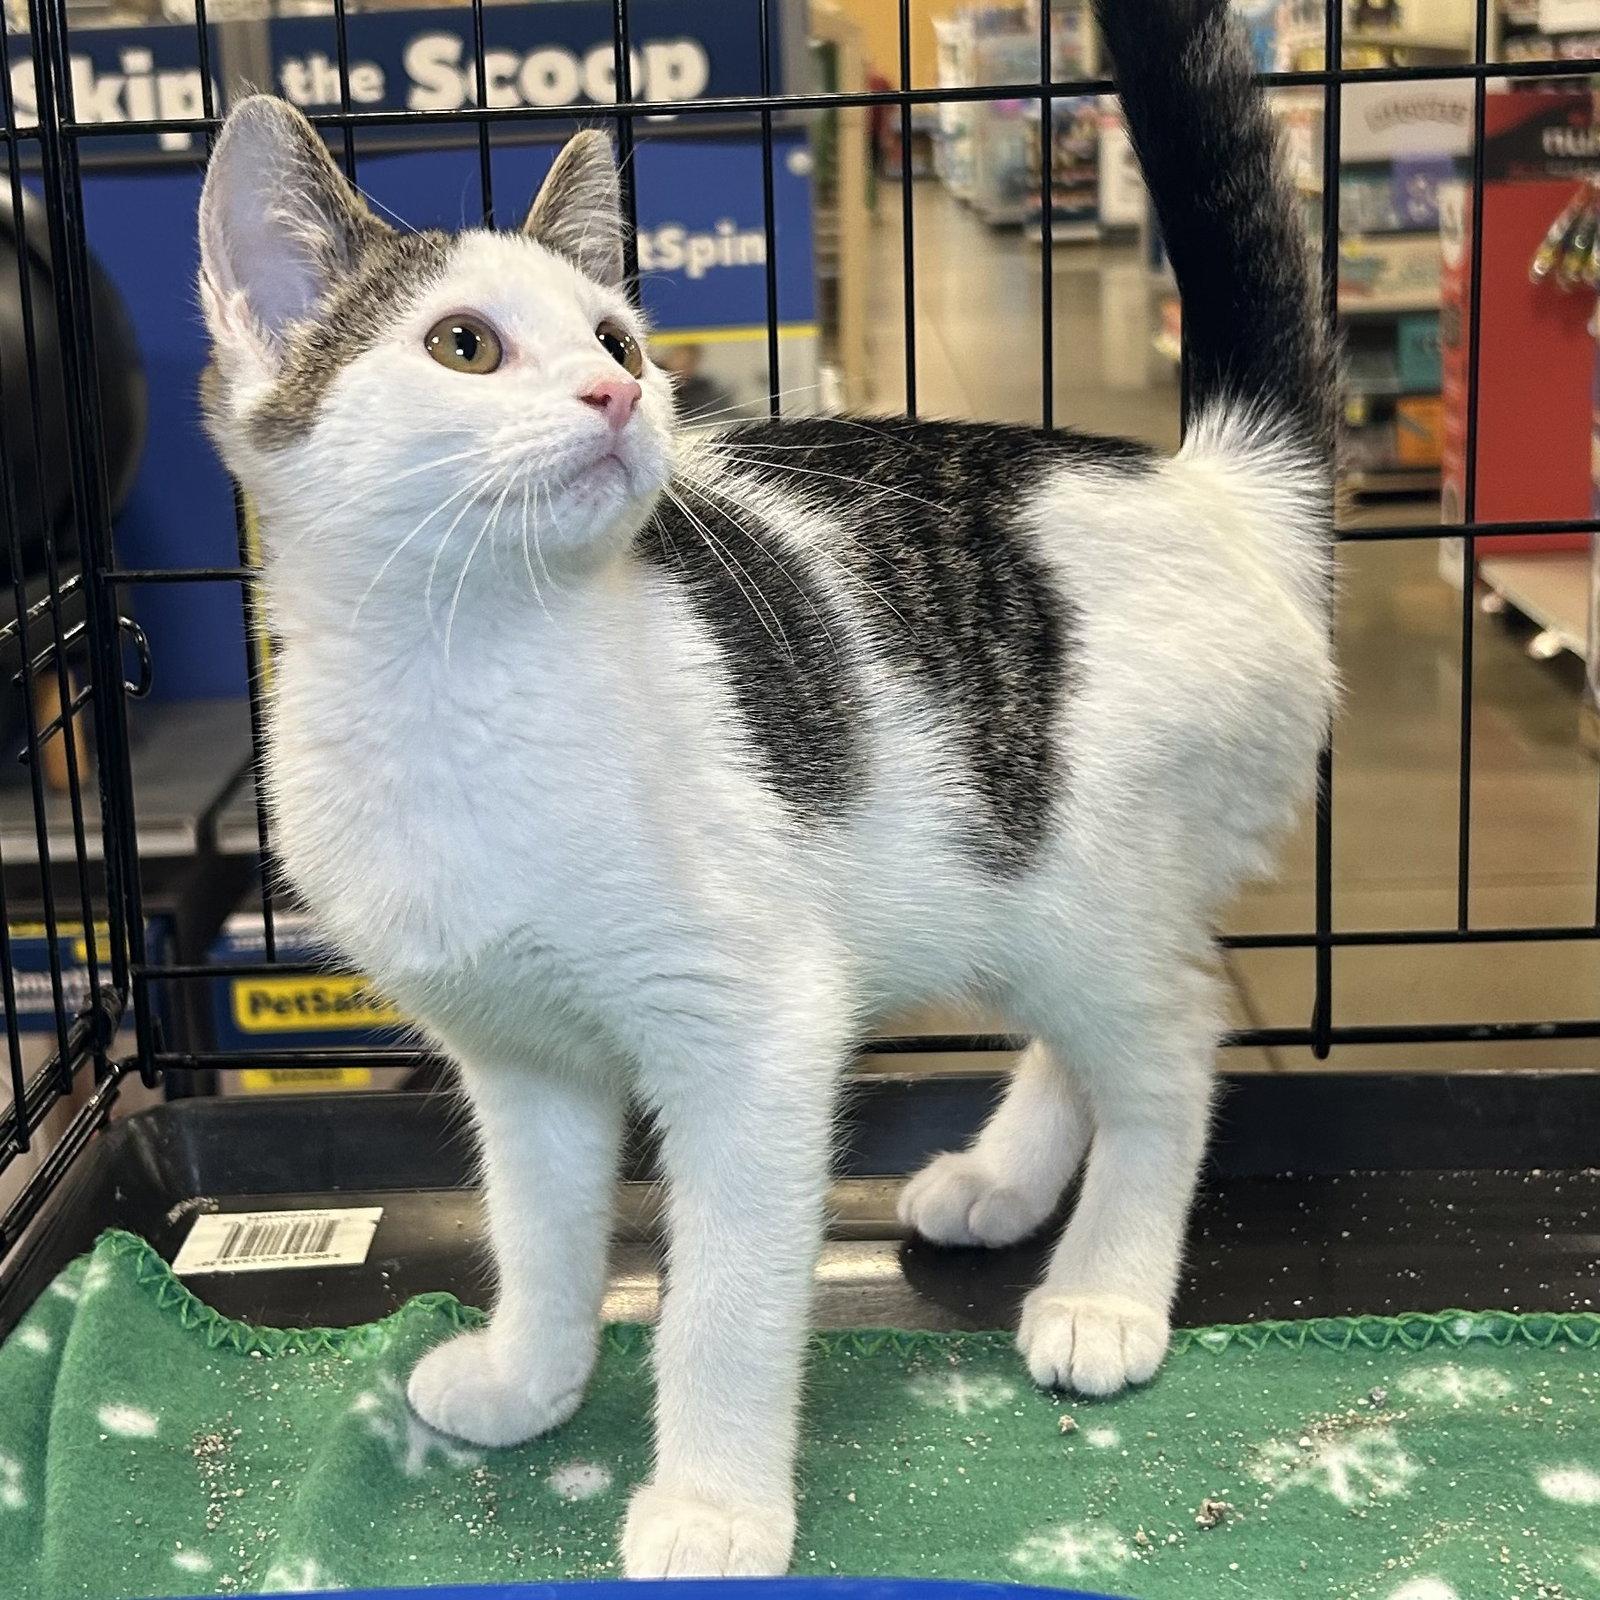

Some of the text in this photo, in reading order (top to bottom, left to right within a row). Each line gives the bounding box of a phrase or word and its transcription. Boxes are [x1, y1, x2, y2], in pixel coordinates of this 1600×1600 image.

[9, 31, 709, 151] Skip the Scoop
